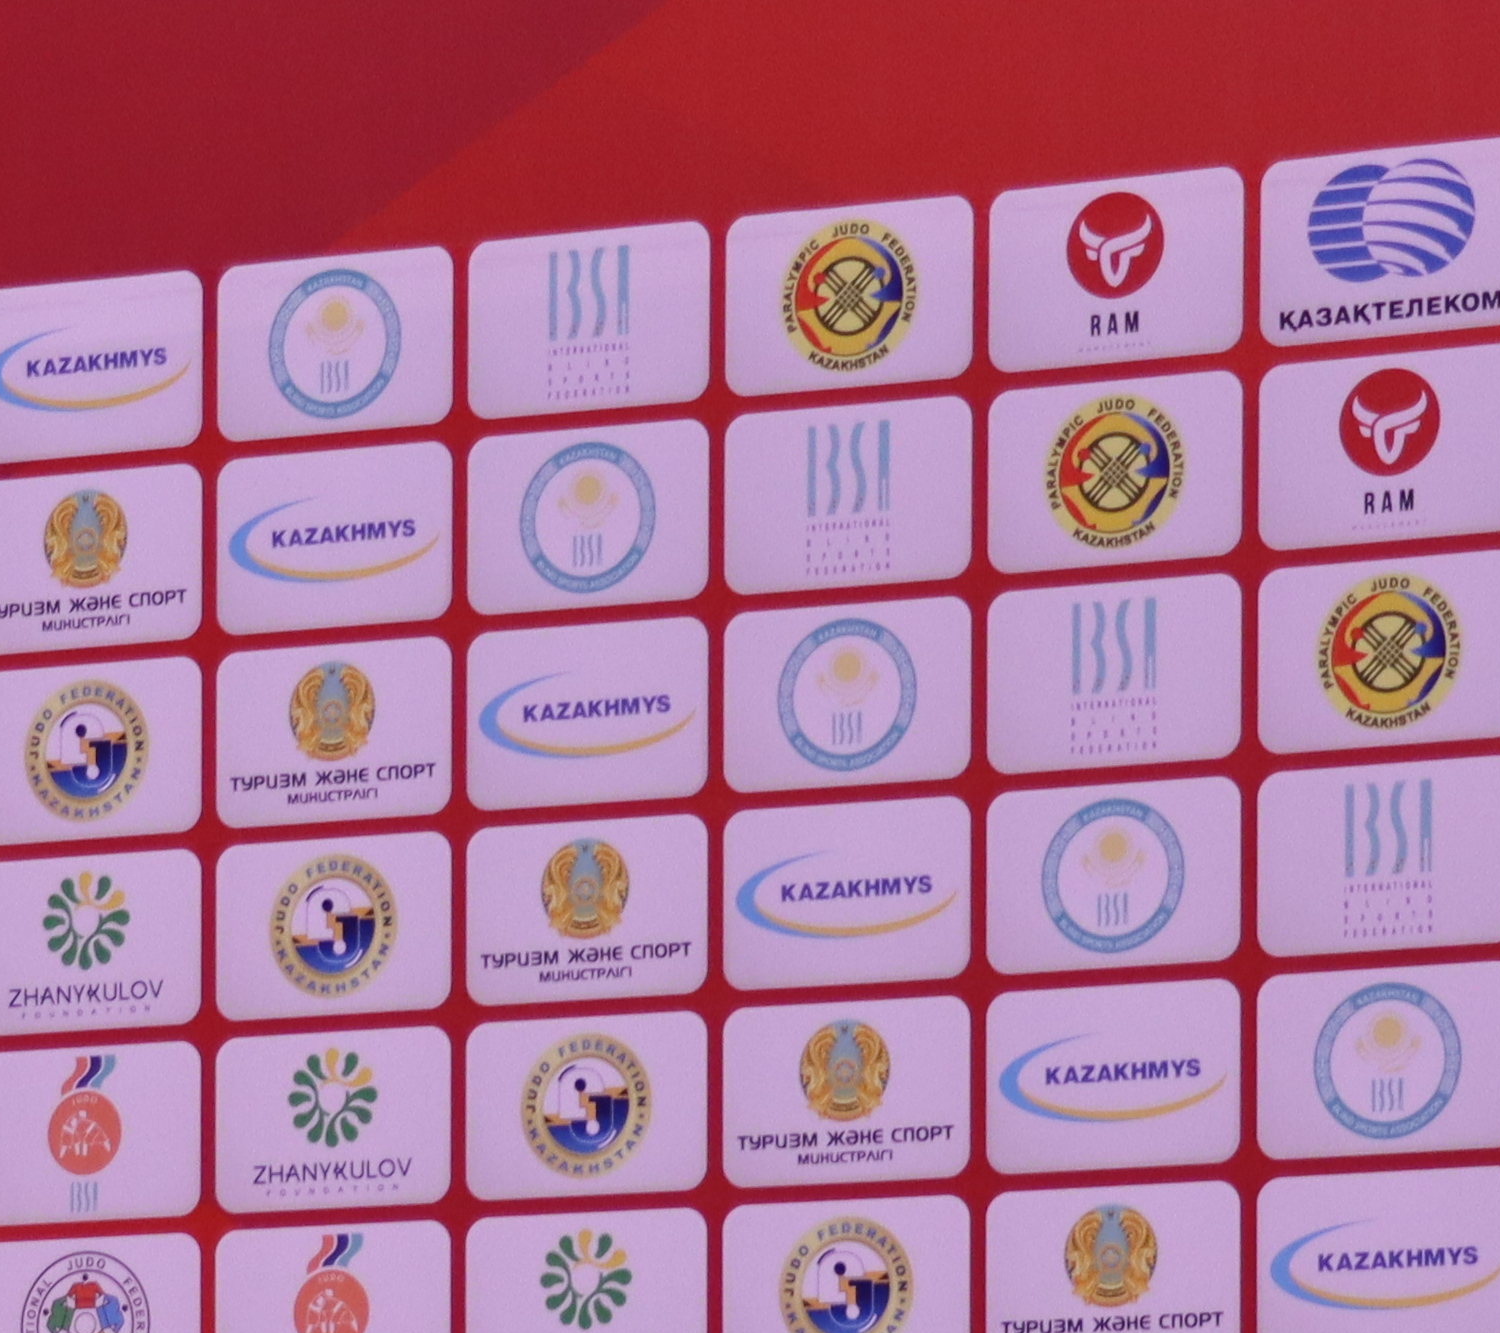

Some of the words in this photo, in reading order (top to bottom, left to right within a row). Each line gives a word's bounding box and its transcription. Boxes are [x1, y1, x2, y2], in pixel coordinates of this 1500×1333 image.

[828, 226, 866, 240] JUDO
[1090, 310, 1139, 336] RAM
[26, 347, 167, 377] KAZAKHMYS
[805, 350, 887, 372] KAZAKHSTAN
[271, 519, 416, 548] KAZAKHMYS
[781, 875, 933, 902] KAZAKHMYS
[8, 980, 164, 1009] ZHANYKULOV
[1318, 1246, 1479, 1272] KAZAKHMYS
